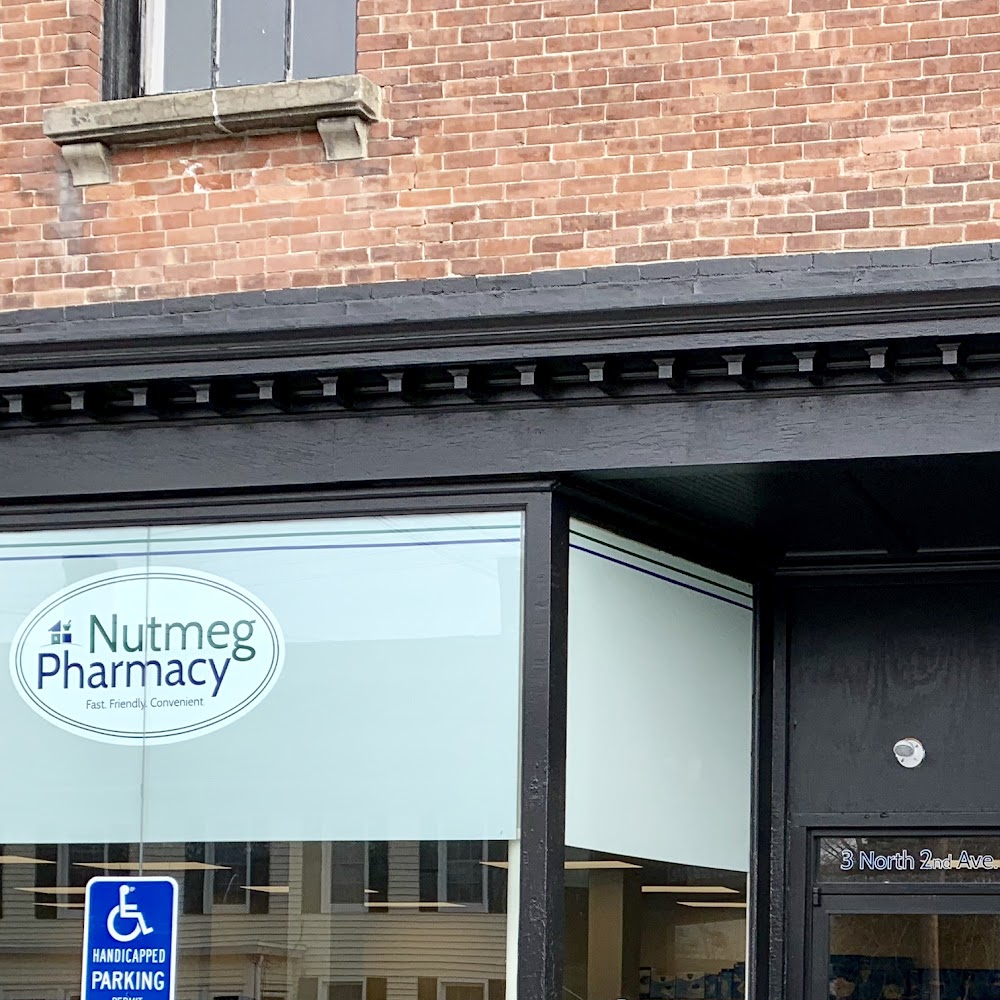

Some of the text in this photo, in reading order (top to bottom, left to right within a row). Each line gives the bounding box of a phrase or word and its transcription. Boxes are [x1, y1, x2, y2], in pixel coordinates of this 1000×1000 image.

[89, 613, 256, 662] Nutmeg
[37, 650, 231, 698] Pharmacy
[86, 699, 107, 710] Fast.
[150, 697, 205, 708] Convenient.
[840, 849, 999, 871] 3 North 2nd Ave.
[92, 948, 166, 963] HANDICAPPED
[91, 970, 165, 991] PARKING
